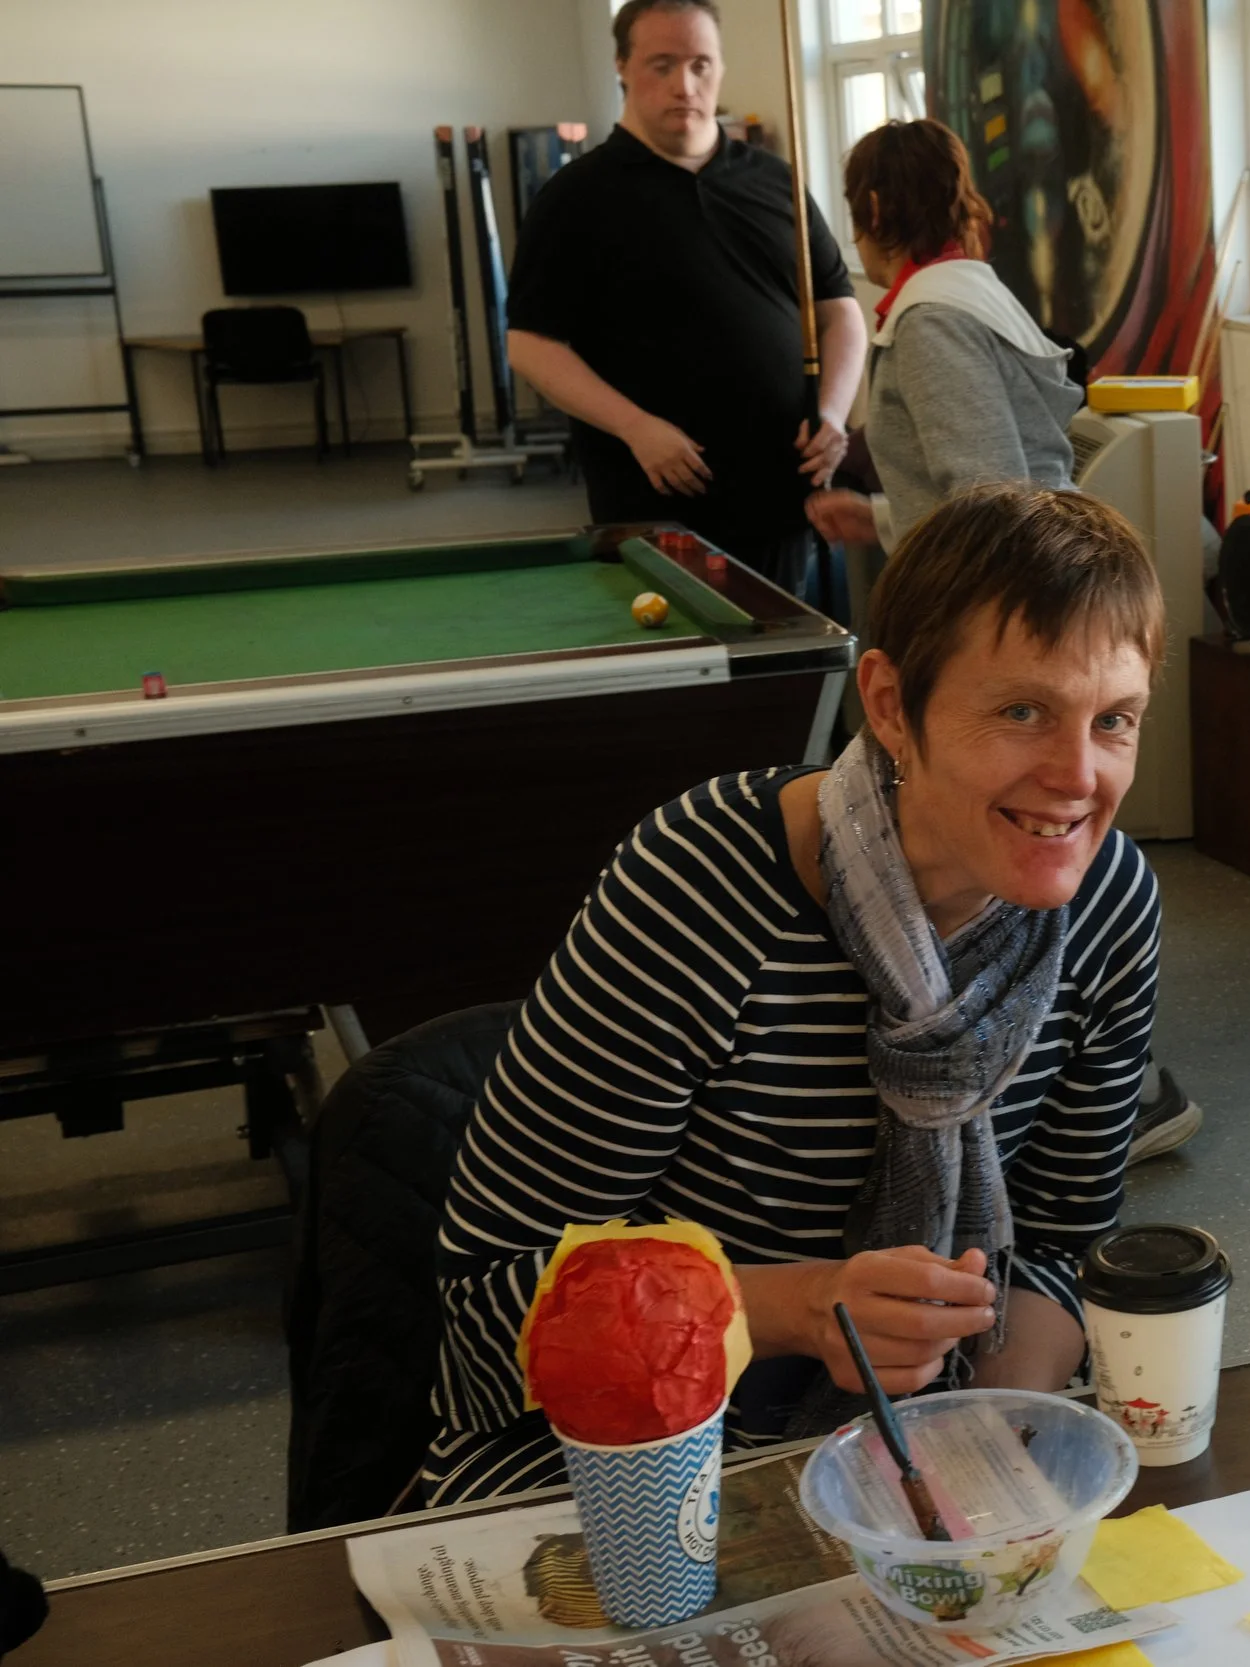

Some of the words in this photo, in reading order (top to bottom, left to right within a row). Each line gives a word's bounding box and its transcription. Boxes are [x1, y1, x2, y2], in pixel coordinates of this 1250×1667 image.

[685, 1472, 708, 1506] TEA
[683, 1531, 704, 1555] HOT
[429, 1544, 463, 1601] meaningful
[463, 1557, 492, 1600] purpose.
[884, 1565, 985, 1589] Mixing
[900, 1585, 967, 1605] Bowl
